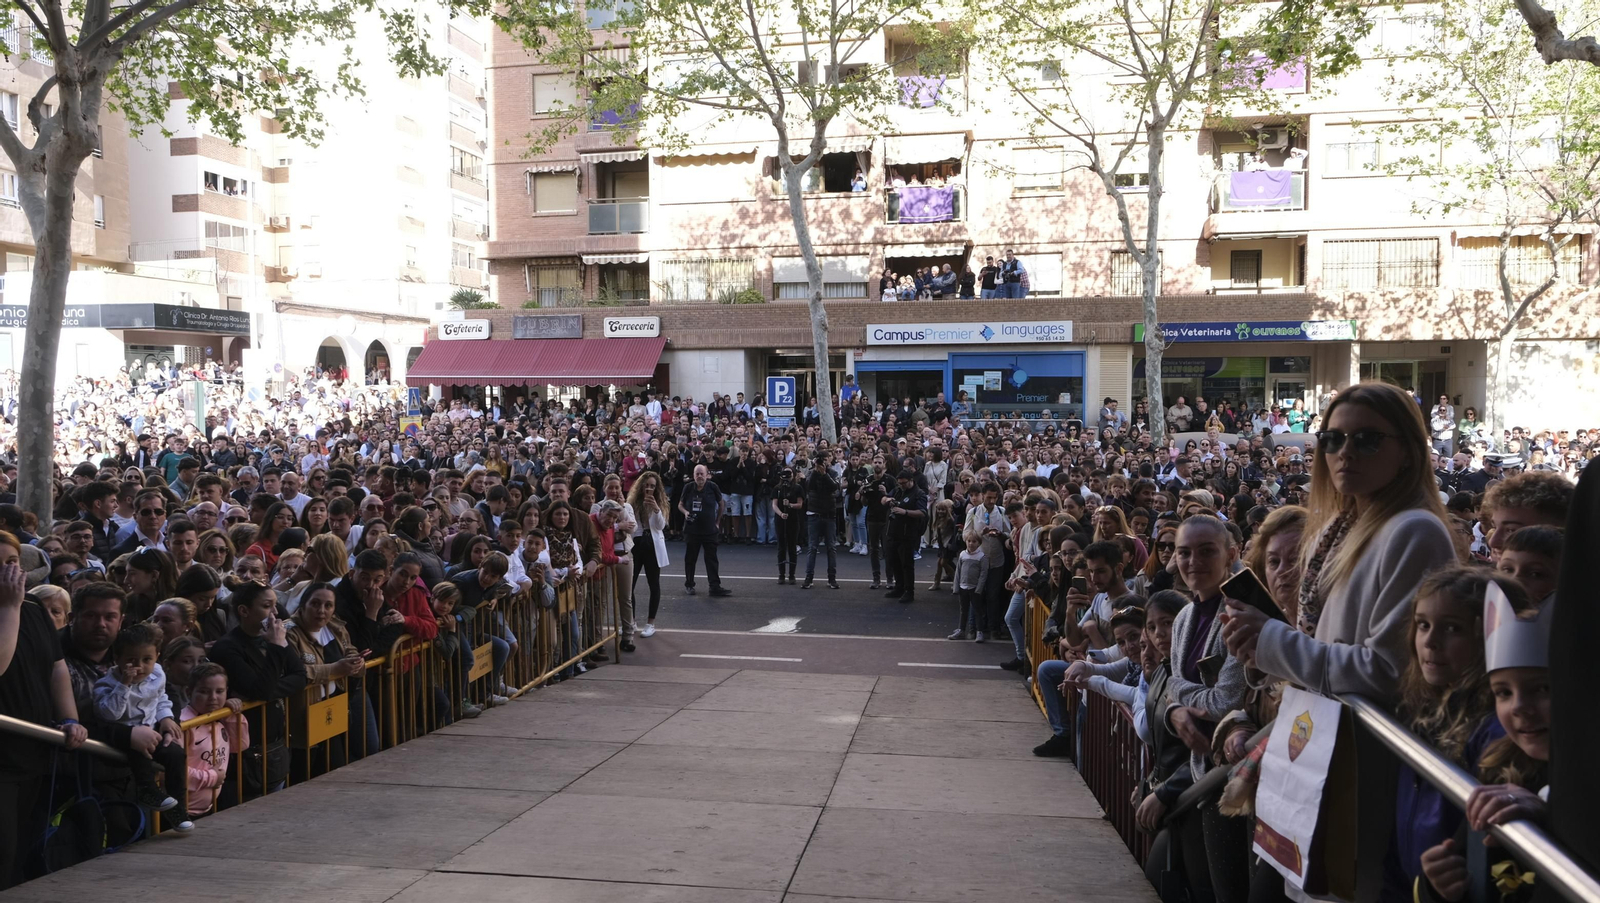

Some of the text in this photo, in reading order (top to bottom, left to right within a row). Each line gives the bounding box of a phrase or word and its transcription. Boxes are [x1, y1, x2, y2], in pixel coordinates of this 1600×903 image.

[63, 308, 85, 318] una
[61, 318, 79, 326] dica
[1001, 323, 1065, 338] languages
[1161, 327, 1301, 337] nica Veterinaria OLIVEROS
[775, 381, 789, 403] P
[782, 395, 792, 403] Z2
[1016, 393, 1049, 403] Premier
